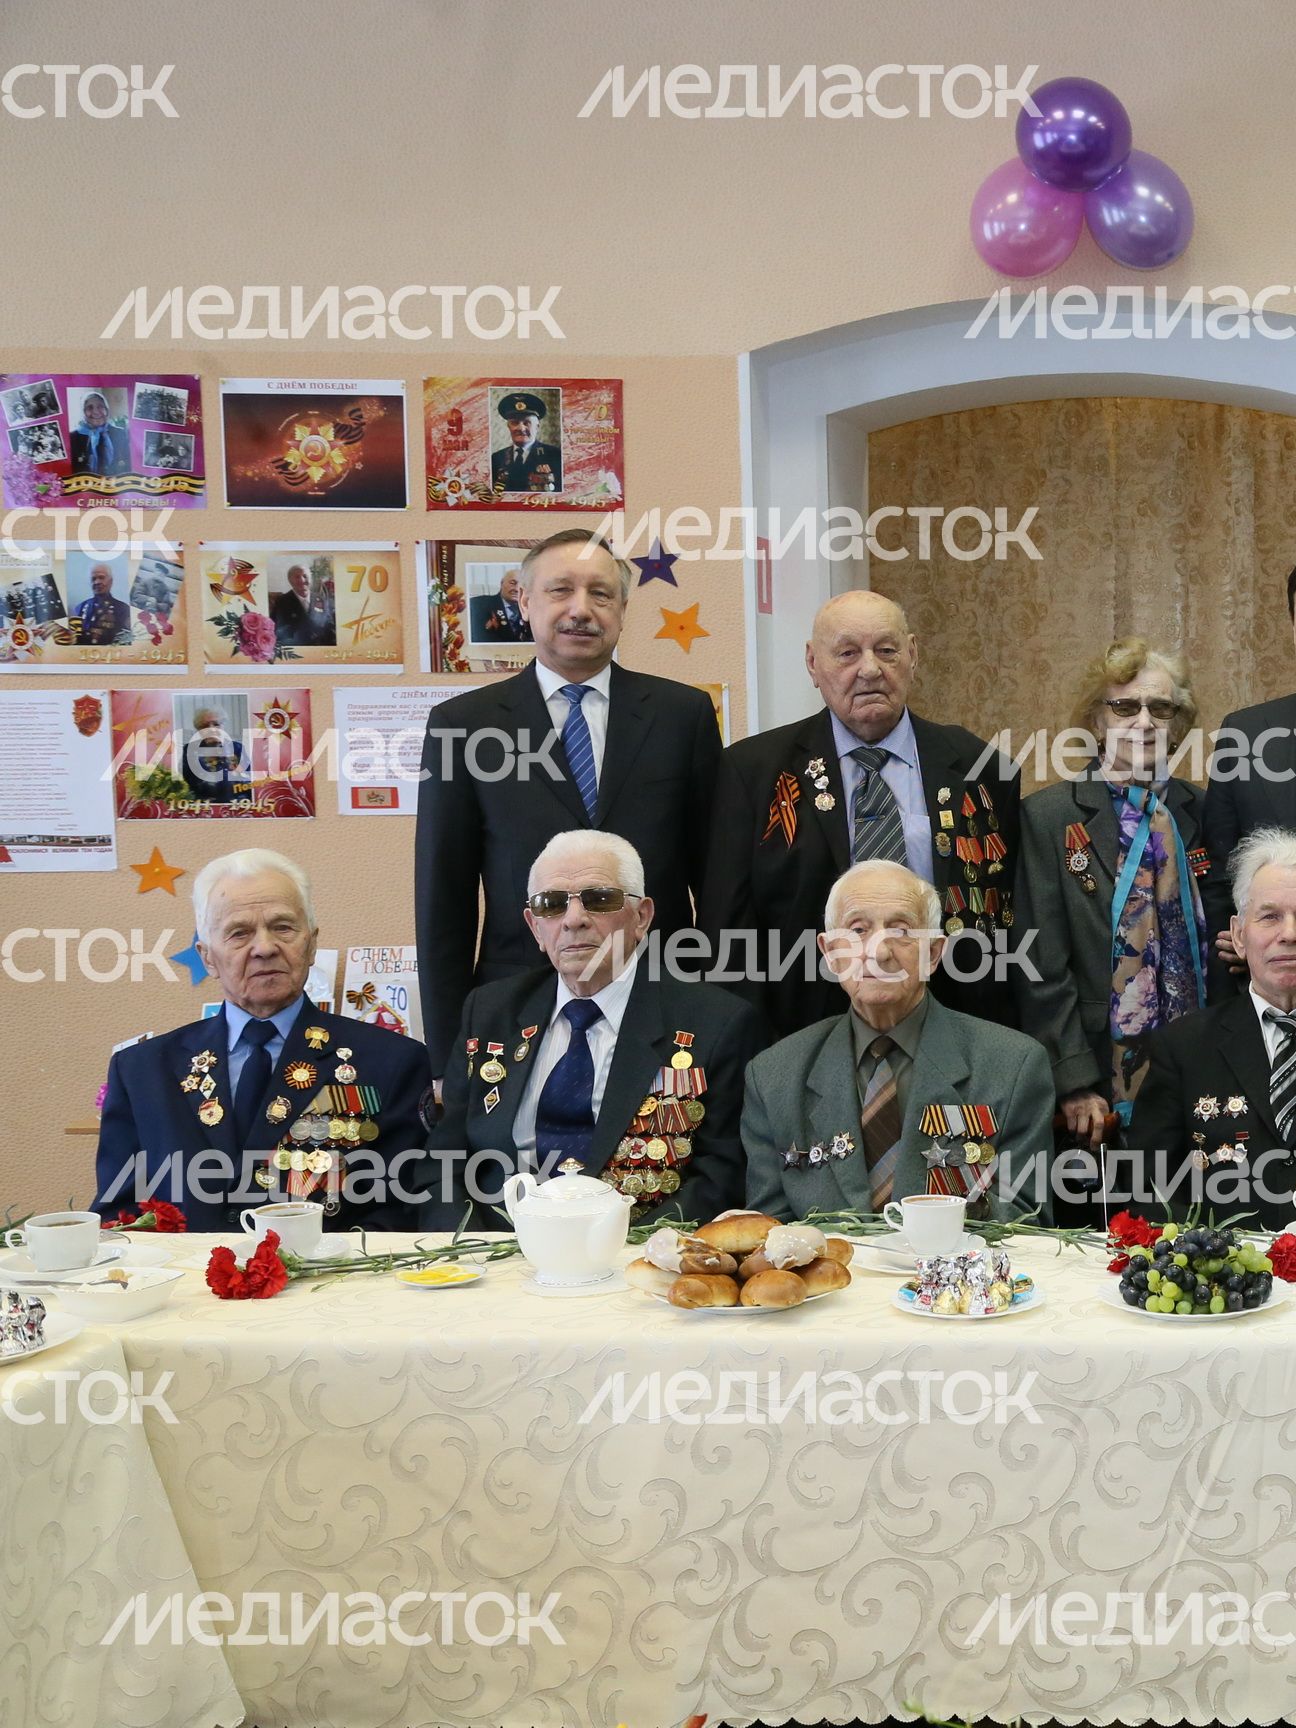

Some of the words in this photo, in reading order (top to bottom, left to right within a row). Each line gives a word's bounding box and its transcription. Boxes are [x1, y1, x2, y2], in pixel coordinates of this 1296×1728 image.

[267, 382, 274, 390] С
[447, 408, 464, 437] 9
[77, 498, 84, 507] С
[347, 565, 389, 593] 70
[167, 798, 211, 815] 1941
[229, 798, 276, 815] 1945
[350, 949, 361, 963] С
[361, 947, 403, 962] ДНЕМ
[386, 985, 408, 1011] 70
